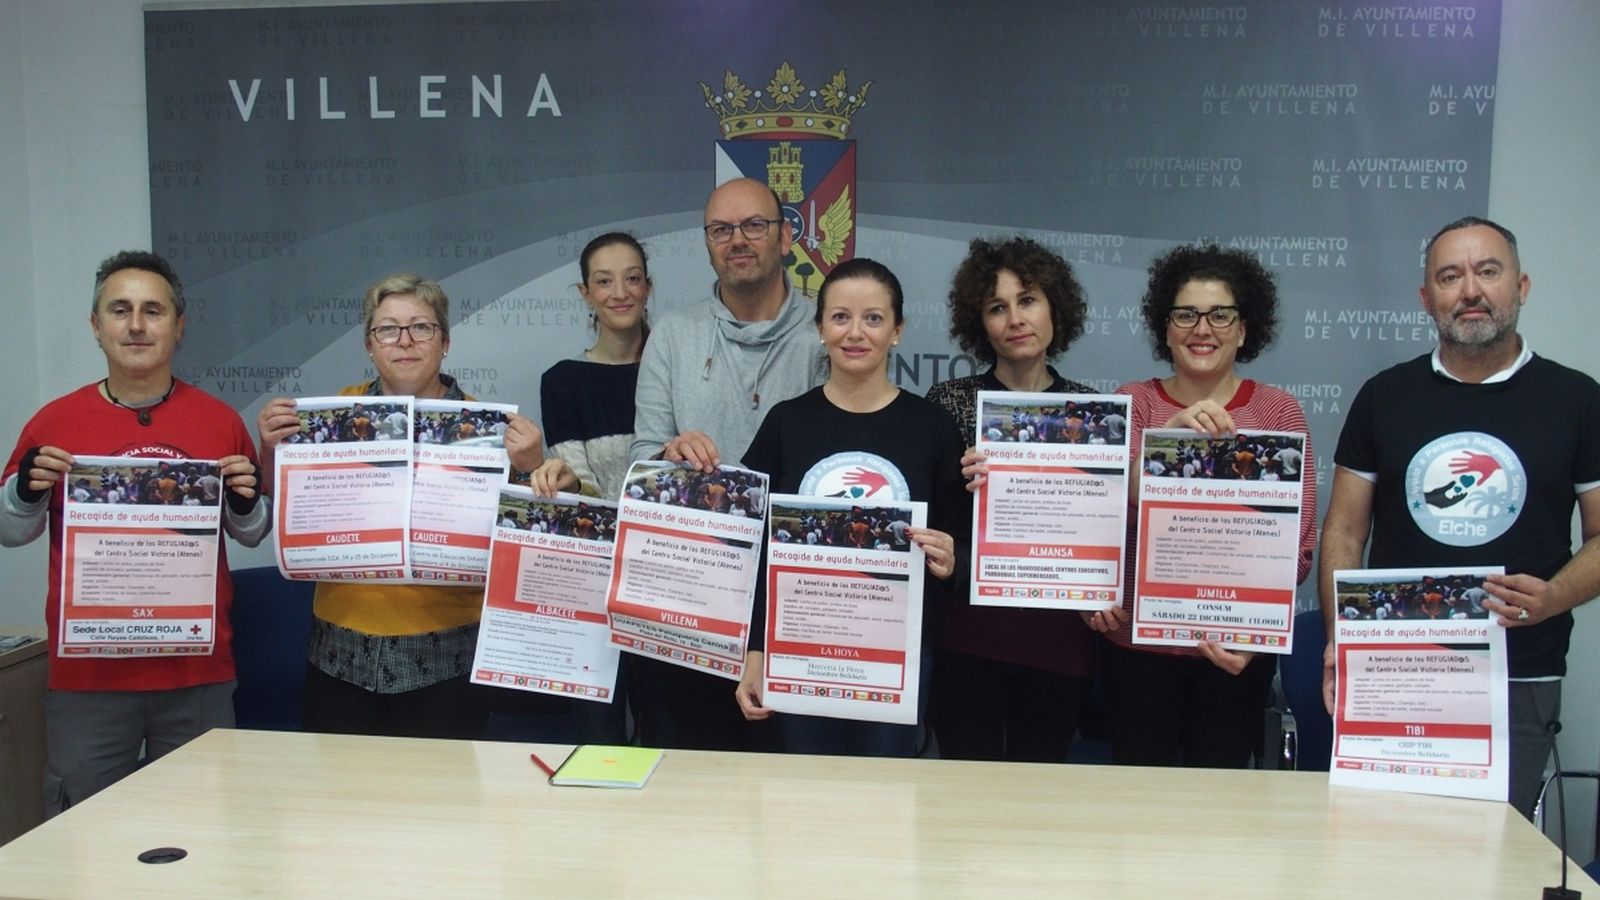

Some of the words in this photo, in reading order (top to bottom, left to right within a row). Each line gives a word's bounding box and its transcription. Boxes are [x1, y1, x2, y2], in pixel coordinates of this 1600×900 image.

[1129, 8, 1248, 22] AYUNTAMIENTO
[1318, 7, 1348, 21] M.I.
[1352, 7, 1476, 21] AYUNTAMIENTO
[1139, 24, 1247, 38] VILLENA
[1317, 24, 1346, 38] DE
[1365, 24, 1475, 39] VILLENA
[228, 73, 563, 123] VILLENA
[1202, 84, 1232, 98] M.I.
[1235, 84, 1358, 98] AYUNTAMIENTO
[1429, 85, 1458, 99] M.I.
[1202, 101, 1229, 115] DE
[1248, 101, 1357, 115] VILLENA
[1428, 102, 1456, 115] DE
[292, 157, 396, 171] AYUNTAMIENTO
[1123, 157, 1243, 172] AYUNTAMIENTO
[1312, 159, 1342, 172] M.I.
[1345, 159, 1469, 173] AYUNTAMIENTO
[303, 172, 397, 187] VILLENA
[1135, 174, 1242, 188] VILLENA
[1312, 175, 1339, 188] DE
[1359, 175, 1467, 190] VILLENA
[168, 231, 191, 244] M.I.
[196, 231, 297, 244] AYUNTAMIENTO
[1228, 236, 1349, 251] AYUNTAMIENTO
[168, 247, 191, 259] DE
[207, 247, 297, 260] VILLENA
[401, 245, 496, 258] VILLENA
[461, 298, 485, 311] M.I.
[461, 313, 486, 326] DE
[1305, 310, 1333, 324] M.I.
[1084, 321, 1111, 335] DE
[1304, 326, 1331, 340] DE
[205, 366, 302, 379] AYUNTAMIENTO
[217, 380, 303, 393] VILLENA
[142, 446, 175, 458] SOCIAL
[284, 451, 319, 459] Recogida
[334, 449, 356, 458] ayuda
[360, 448, 407, 456] humanitaria
[1425, 437, 1469, 457] Personas
[434, 451, 457, 460] ayuda
[1027, 451, 1036, 459] de
[1040, 452, 1066, 461] ayuda
[1069, 453, 1124, 462] humanitaria
[1144, 484, 1188, 496] Recogida
[1192, 486, 1202, 495] de
[1206, 488, 1235, 498] ayuda
[1239, 489, 1298, 499] humanitaria
[70, 510, 114, 522] Recogida
[117, 512, 128, 521] de
[131, 513, 159, 524] ayuda
[163, 513, 218, 522] humanitaria
[623, 506, 662, 520] Recogida
[665, 513, 676, 522] de
[678, 516, 705, 528] ayuda
[708, 520, 761, 536] humanitaria
[1438, 520, 1487, 536] Elche
[326, 534, 360, 543] CAUDETE
[413, 532, 448, 544] CAUDETE
[498, 530, 535, 544] Recogida
[550, 539, 576, 549] ayuda
[772, 550, 812, 561] Recogida
[814, 554, 824, 562] de
[826, 556, 853, 564] ayuda
[856, 558, 908, 568] humanitaria
[1028, 547, 1073, 557] ALMANSA
[1196, 588, 1237, 599] JUMILLA
[132, 608, 155, 618] SAX
[536, 605, 576, 618] ALBACETE
[1197, 604, 1232, 612] CONSUM
[661, 612, 698, 628] VILLENA
[1152, 611, 1185, 619] SÁBADO
[1199, 614, 1244, 623] DICIEMBRE
[72, 626, 96, 634] Sede
[99, 625, 124, 634] Local
[126, 625, 153, 634] CRUZ
[156, 625, 182, 633] ROJA
[1341, 628, 1381, 639] Recogida
[1385, 628, 1394, 636] de
[1398, 629, 1426, 638] ayuda
[1429, 627, 1487, 637] humanitaria
[820, 647, 832, 656] LA
[834, 649, 860, 657] HOYA
